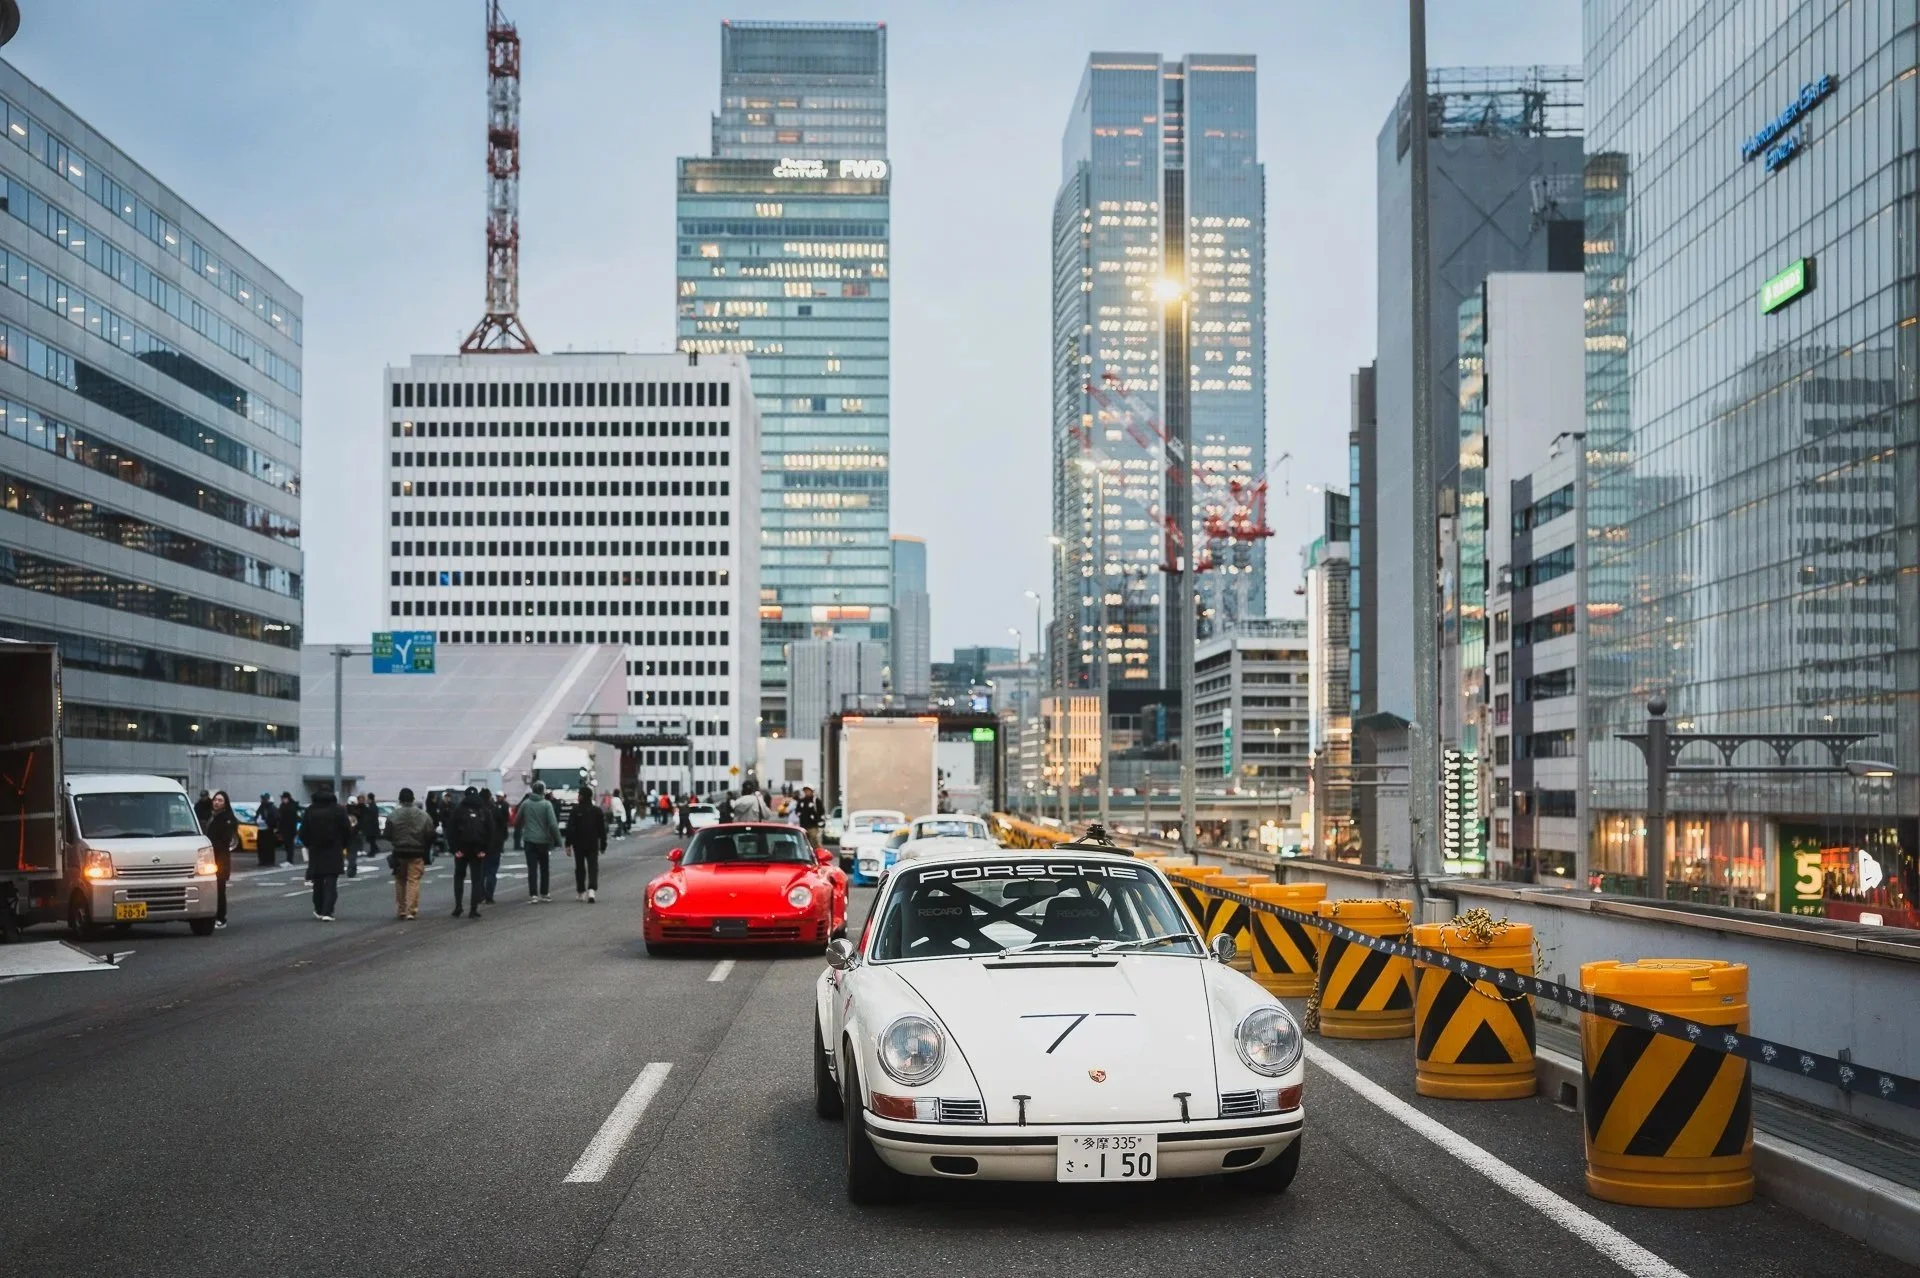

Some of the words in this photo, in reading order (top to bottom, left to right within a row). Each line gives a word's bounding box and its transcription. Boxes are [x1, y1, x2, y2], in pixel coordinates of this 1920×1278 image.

[839, 159, 887, 179] FWD
[919, 864, 1139, 884] PORSCHE
[917, 905, 963, 918] RECARO
[1082, 1137, 1109, 1150] 多摩
[1112, 1136, 1136, 1149] 335
